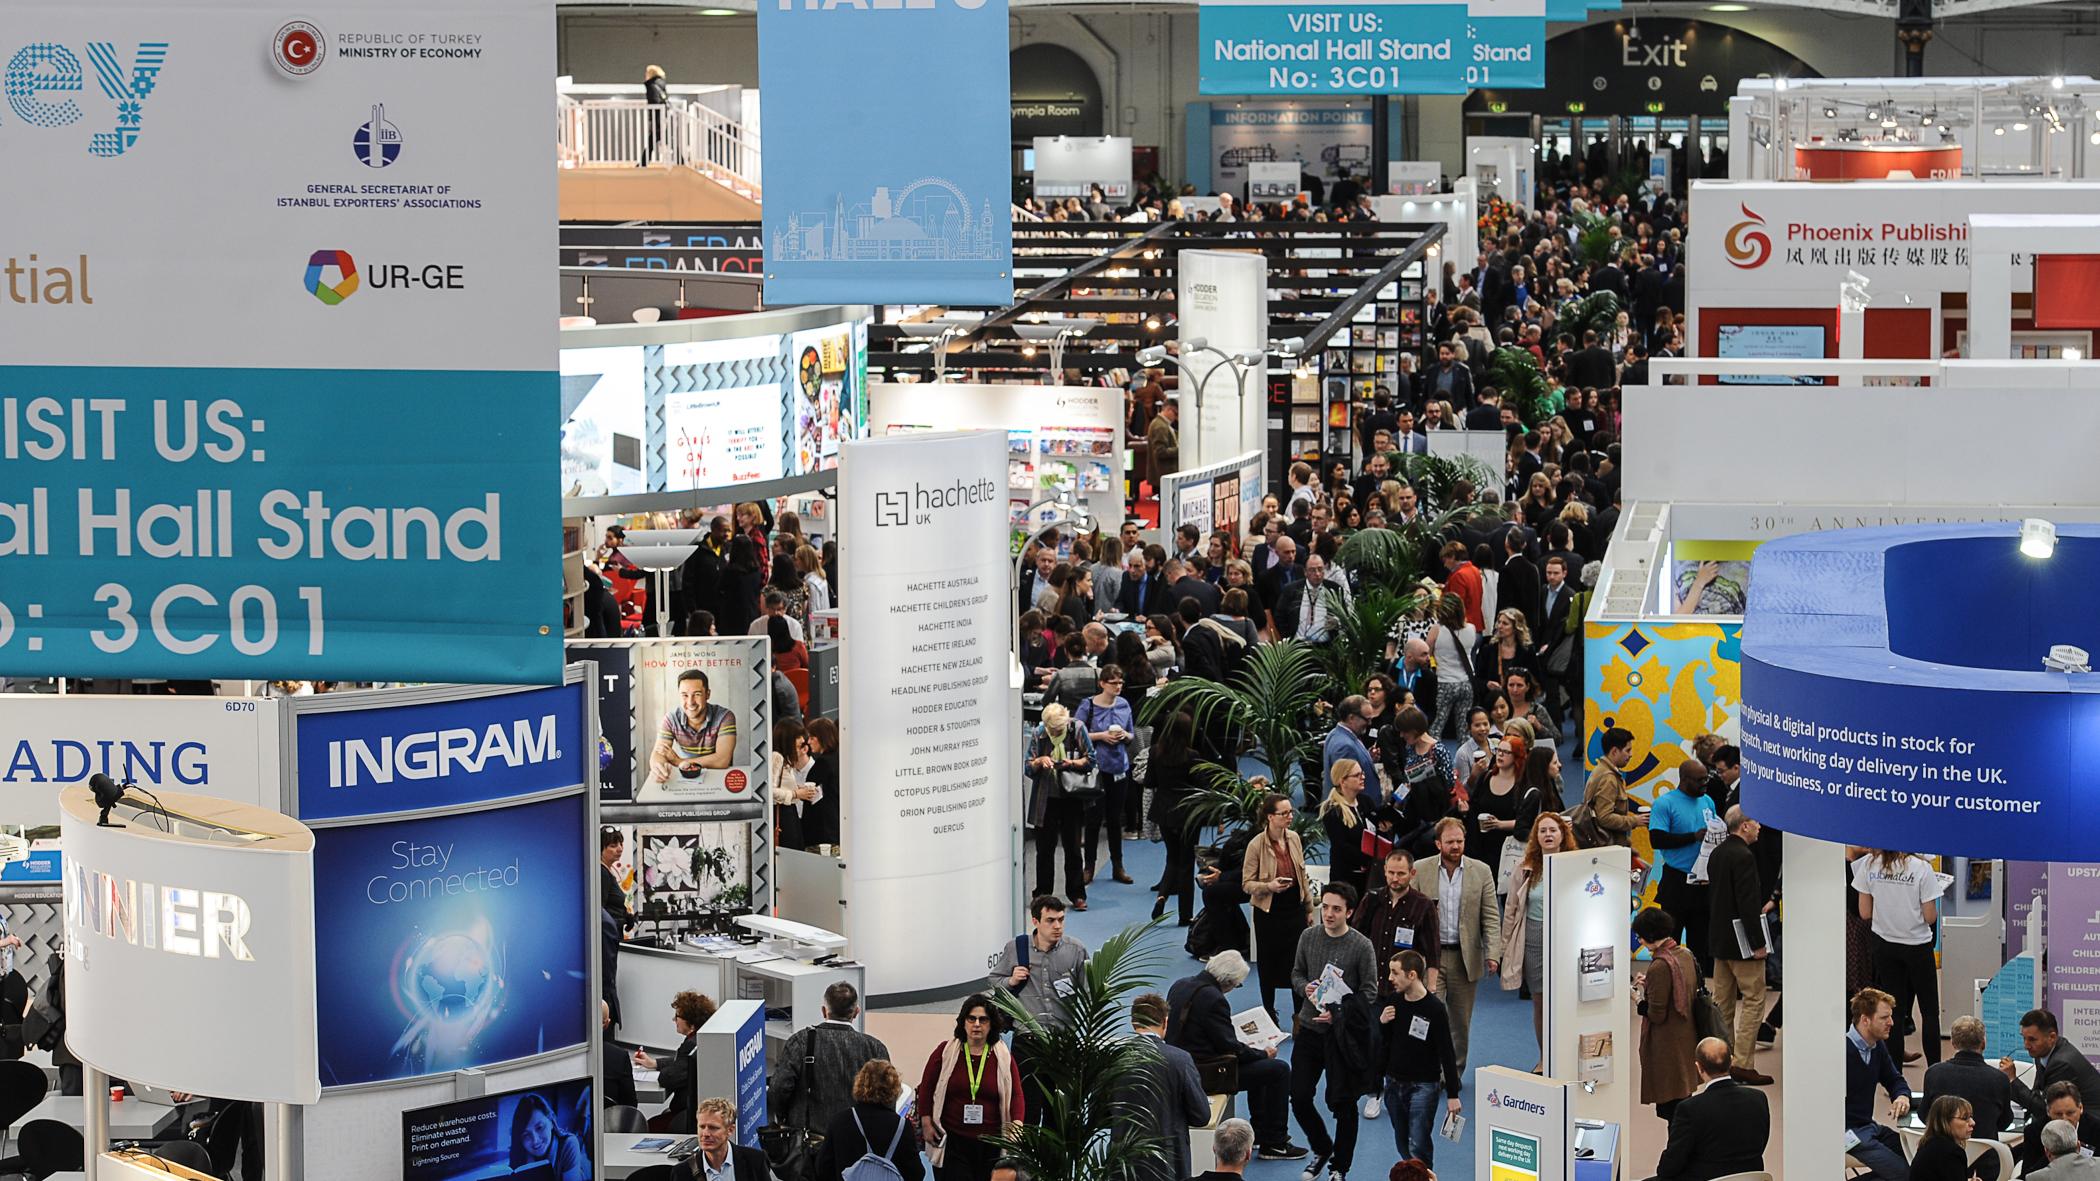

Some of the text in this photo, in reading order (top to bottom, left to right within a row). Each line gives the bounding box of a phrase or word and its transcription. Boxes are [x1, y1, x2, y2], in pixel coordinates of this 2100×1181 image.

[1287, 13, 1383, 33] VISIT US:
[338, 34, 482, 45] REPUBLIC OF TURKEY
[339, 48, 482, 58] MINISTRY OF ECONOMY
[1215, 38, 1451, 62] National Hall Stand
[1472, 44, 1532, 62] Stand
[1623, 34, 1687, 68] Exit
[1269, 66, 1400, 89] No: 3C01
[1047, 105, 1080, 116] Room
[1226, 112, 1364, 123] INFORMATION POINT
[307, 185, 451, 195] GENERAL SECRETARIAT OF
[334, 198, 400, 208] EXPORTERS'
[403, 199, 482, 209] ASSOCIATIONS
[1787, 223, 1968, 241] Phoenix Publishi
[4, 254, 94, 305] tial
[367, 264, 465, 291] UR-GE
[2, 397, 266, 464] ISIT US:
[916, 477, 995, 510] hachette
[78, 487, 501, 562] Hall Stand
[916, 513, 931, 525] UK
[907, 576, 979, 592] HACHETTE AUSTRALIA
[890, 594, 989, 614] HACHETTE CHILDREN'S GROUP
[90, 583, 325, 656] 3C01
[918, 618, 973, 632] HACHETTE INDIA
[912, 637, 977, 653] HACHETTE IRELAND
[644, 659, 742, 668] HOW TO EAT BETTER
[901, 656, 983, 675] HACHETTE NEW ZEALAND
[891, 675, 989, 696] HEADLINE PUBLISHING GROUP
[225, 701, 256, 713] 6D70
[912, 699, 977, 715] HODDER EDUCATION
[906, 718, 981, 736] HODDER & STOUGHTON
[1747, 705, 1773, 728] physical
[1773, 714, 1781, 729] &
[1782, 716, 1815, 738] digital
[1818, 727, 1878, 747] products
[1882, 732, 1897, 748] in
[1900, 736, 1945, 753] stock
[1949, 738, 1975, 755] for
[910, 738, 979, 756] JOHN MURRAY PRESS
[2, 739, 210, 785] ADING
[895, 756, 988, 777] LITTLE, BROWN BOOK GROUP
[1763, 739, 2008, 785] next working day delivery in the UK.
[894, 776, 989, 798] OCTOPUS PUBLISHING GROUP
[1751, 763, 2042, 814] to your business, or direct to your customer
[900, 797, 985, 818] ORION PUBLISHING GROUP
[933, 822, 965, 835] QUERCUS
[392, 840, 454, 873] Stay
[367, 857, 519, 905] Connected
[1869, 871, 1915, 883] pubmatch
[2052, 982, 2069, 991] THE
[739, 1028, 763, 1072] INGRAM
[1503, 1095, 1545, 1116] Gardners
[411, 1123, 438, 1134] Reduce
[439, 1115, 477, 1127] warehouse
[411, 1131, 445, 1143] Eliminate
[1495, 1136, 1507, 1144] Same
[1506, 1139, 1515, 1148] day
[411, 1143, 429, 1153] Print
[430, 1141, 440, 1149] on
[1498, 1150, 1513, 1160] delivery
[1507, 1147, 1523, 1157] working
[1523, 1149, 1531, 1158] day
[412, 1152, 460, 1167] Lightning Source
